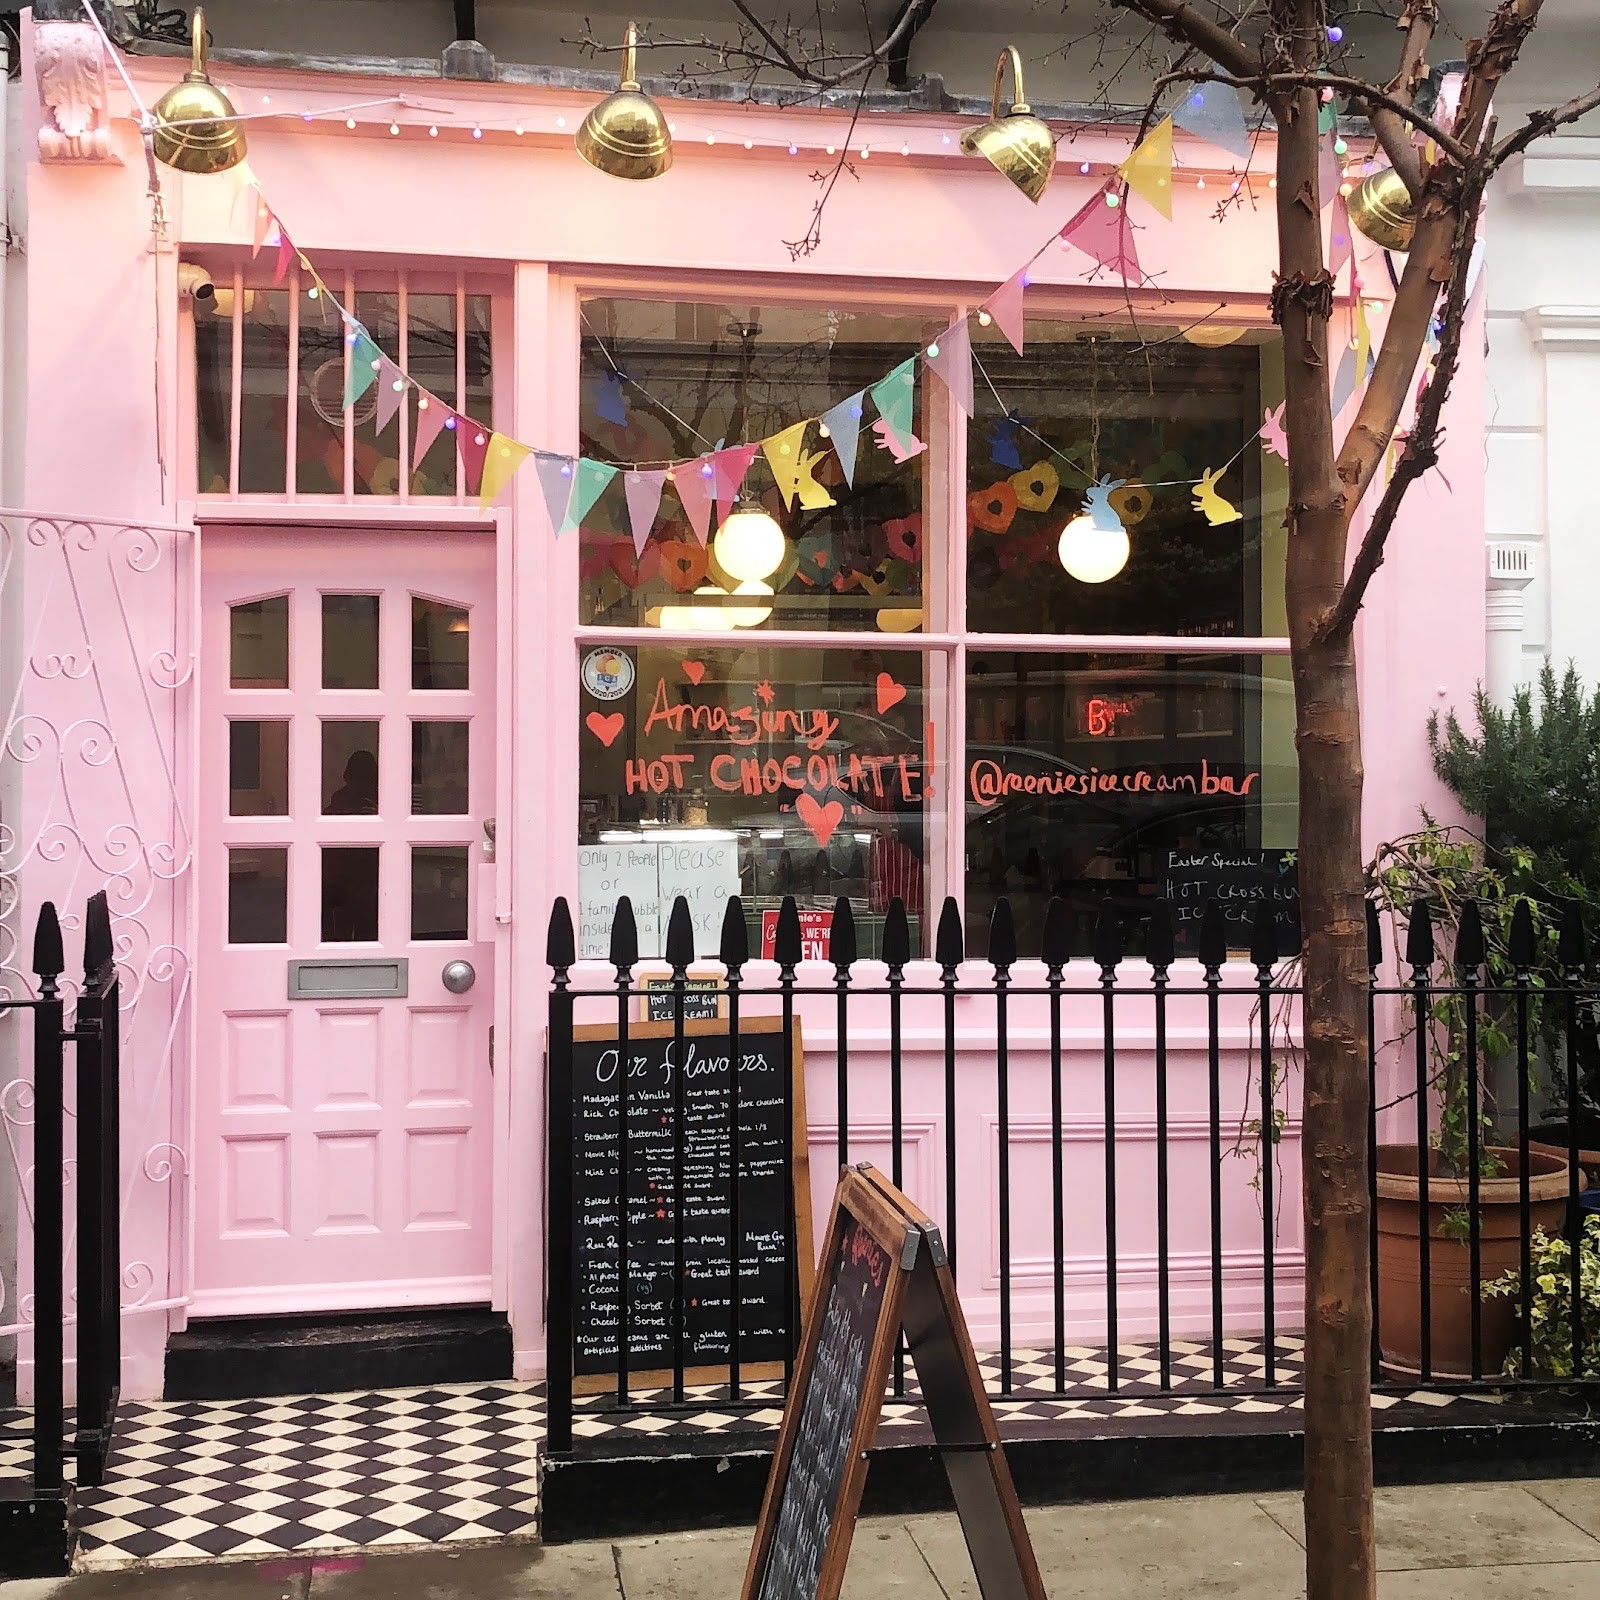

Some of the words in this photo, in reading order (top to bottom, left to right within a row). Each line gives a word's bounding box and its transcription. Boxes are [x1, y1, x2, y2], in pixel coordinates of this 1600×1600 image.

[594, 649, 622, 658] MEMBER
[591, 687, 625, 698] 2020/2021
[644, 677, 840, 750] Amazing
[625, 753, 695, 795] HOT
[710, 721, 935, 803] CHOCOLATE!
[579, 850, 608, 872] Only
[616, 850, 622, 867] 2
[661, 845, 725, 871] Please
[1168, 851, 1209, 868] Easter
[600, 878, 620, 891] or
[1166, 879, 1208, 899] HOT
[1217, 884, 1266, 899] CROSS
[714, 885, 728, 898] a
[588, 901, 616, 917] famil
[1178, 906, 1204, 921] IC
[644, 923, 652, 932] a
[801, 941, 823, 960] EN
[650, 994, 668, 1006] HOT
[652, 1010, 674, 1021] ICE
[638, 1090, 671, 1101] Vanilla
[583, 1109, 604, 1118] Rich
[584, 1132, 619, 1142] Strawberr
[584, 1168, 605, 1177] Mint
[584, 1196, 611, 1207] Salted
[701, 1235, 726, 1246] plenty
[690, 1268, 714, 1279] Great
[634, 1300, 664, 1311] Sorbet
[634, 1316, 666, 1326] Sorbet
